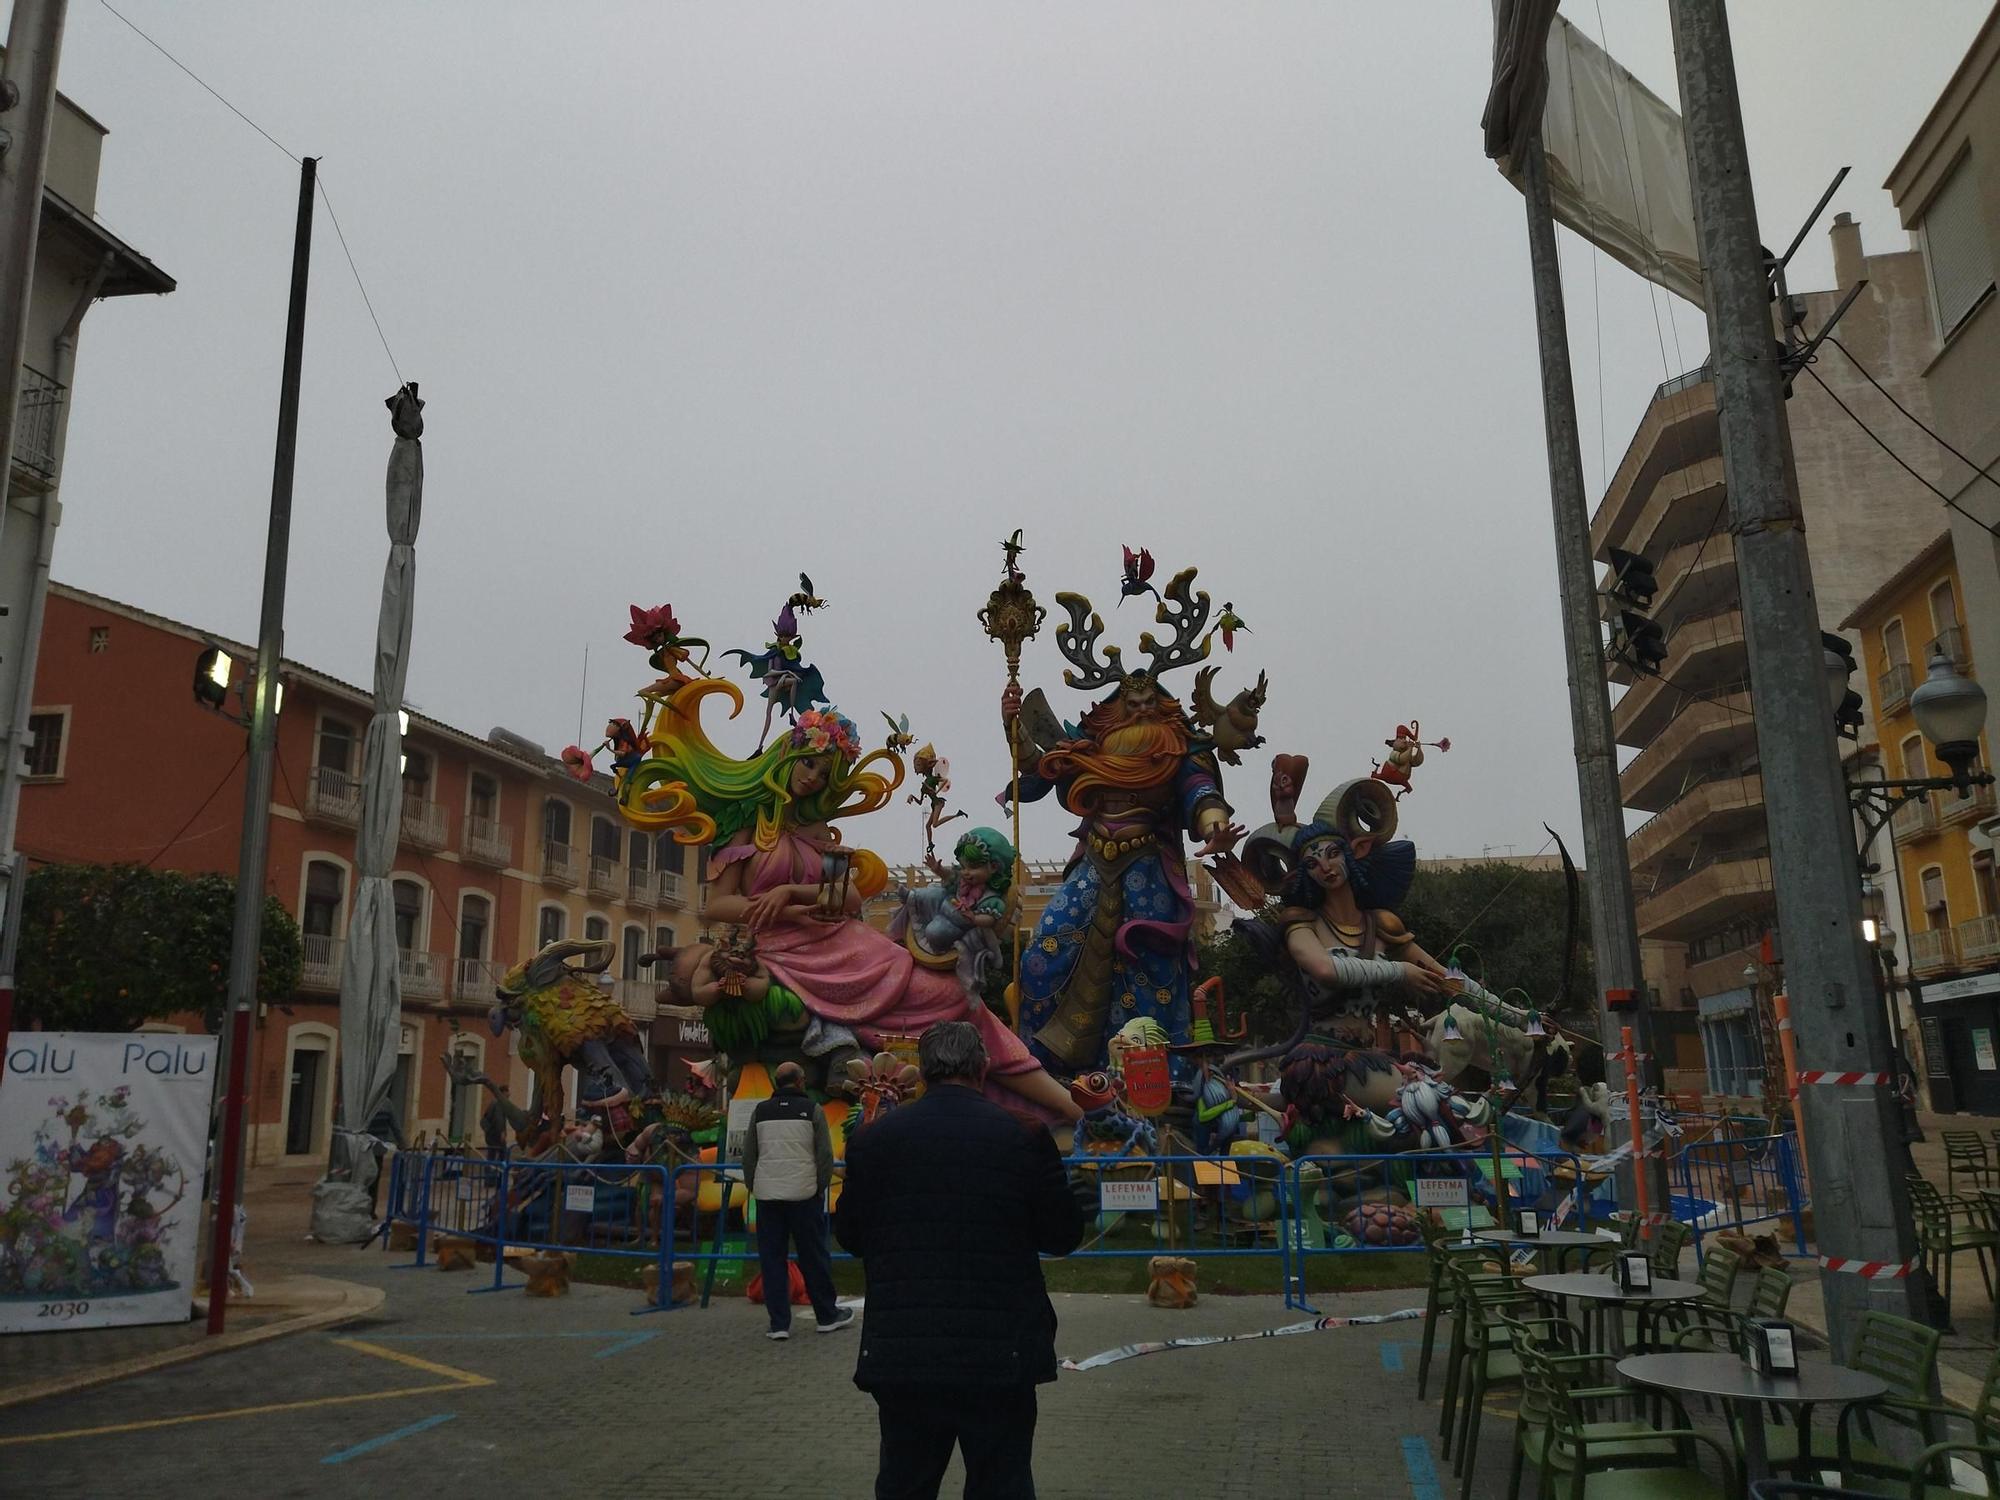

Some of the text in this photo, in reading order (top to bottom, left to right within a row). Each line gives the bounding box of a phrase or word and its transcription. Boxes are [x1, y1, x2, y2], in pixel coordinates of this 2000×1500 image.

[5, 1042, 75, 1074] alu
[123, 1043, 206, 1075] Palu
[1105, 1183, 1152, 1193] LEFEYMA
[1420, 1180, 1463, 1190] LEFEYMA
[37, 1302, 90, 1321] 2030
